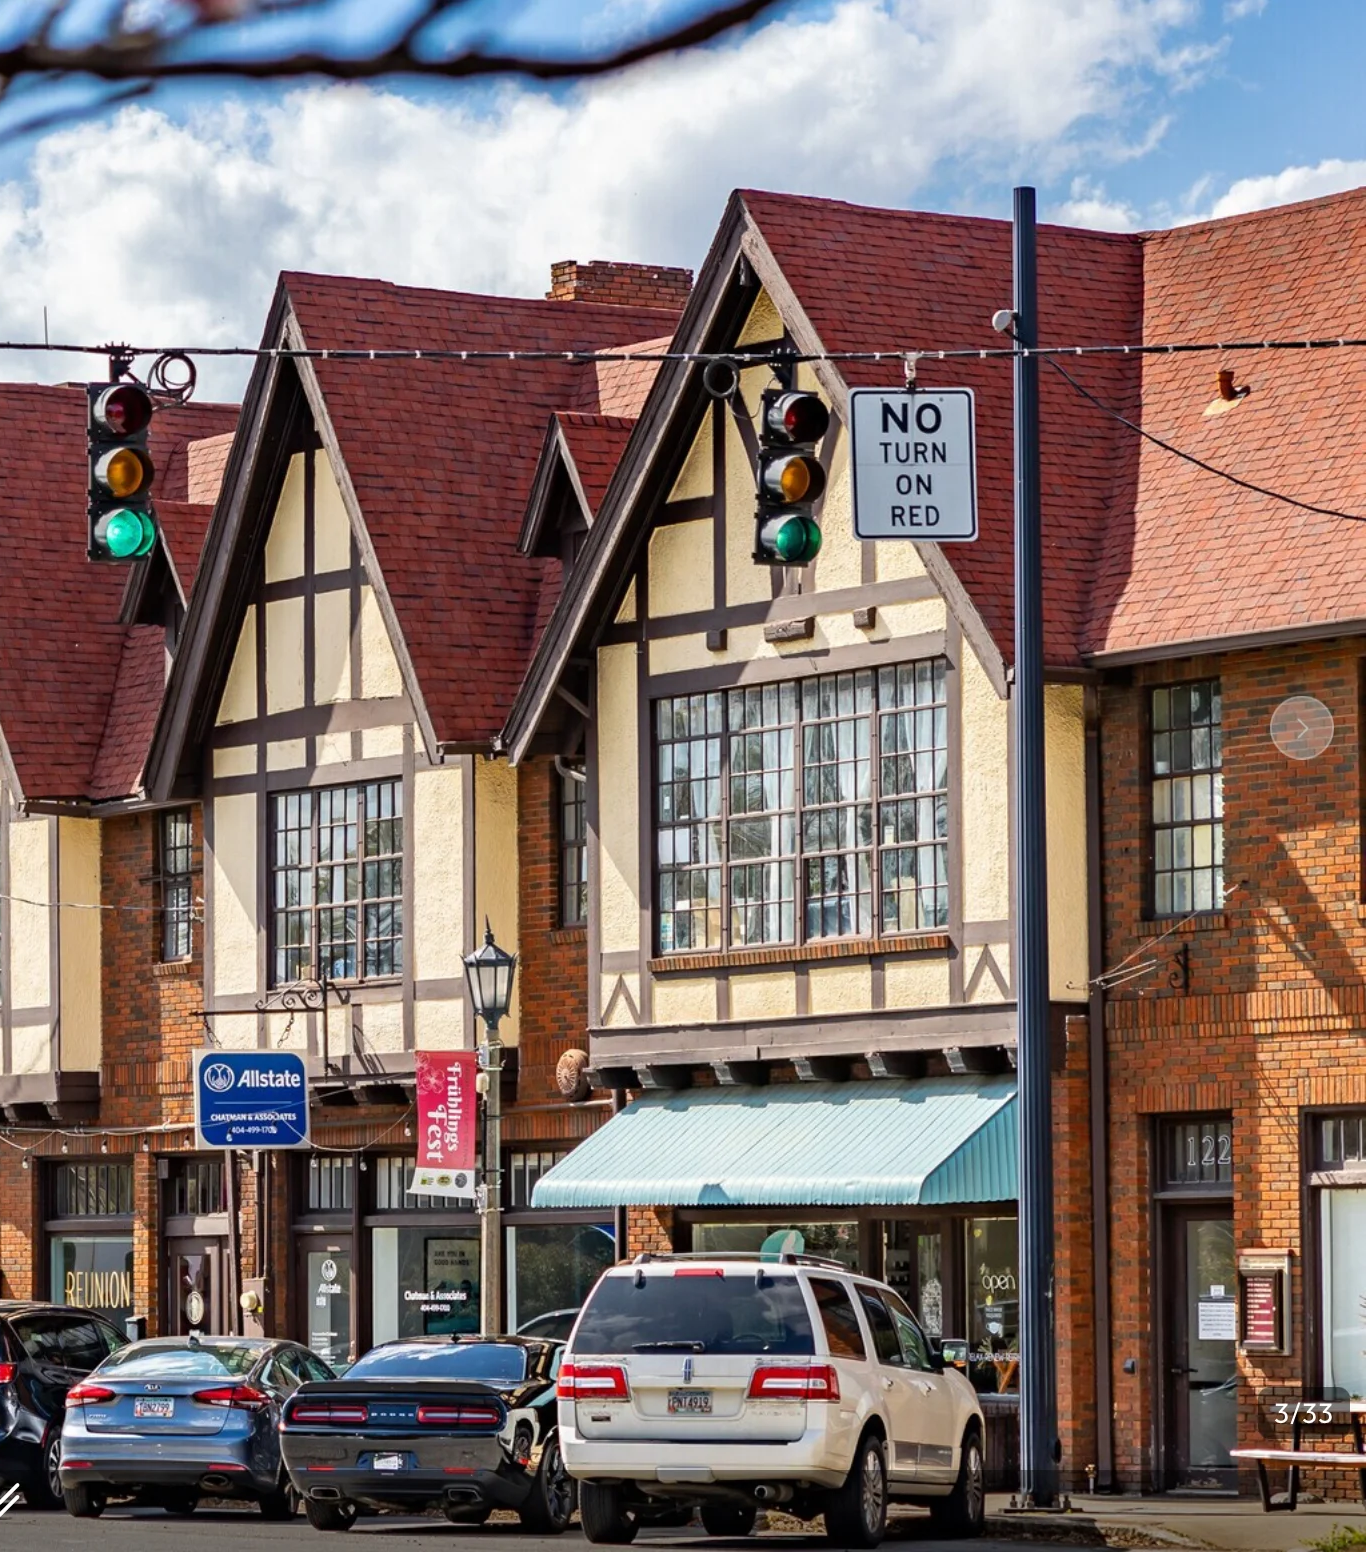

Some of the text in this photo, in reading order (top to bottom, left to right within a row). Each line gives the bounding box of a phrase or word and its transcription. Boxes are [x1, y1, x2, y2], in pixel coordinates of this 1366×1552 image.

[881, 402, 942, 434] NO
[879, 442, 947, 463] TURN
[896, 474, 932, 495] ON
[891, 505, 940, 526] RED
[237, 1069, 301, 1088] Allstate
[231, 1126, 278, 1134] 404-499-170
[426, 1104, 448, 1163] Fest
[1187, 1134, 1232, 1166] 122
[65, 1270, 131, 1309] REUNION
[982, 1274, 1016, 1293] open
